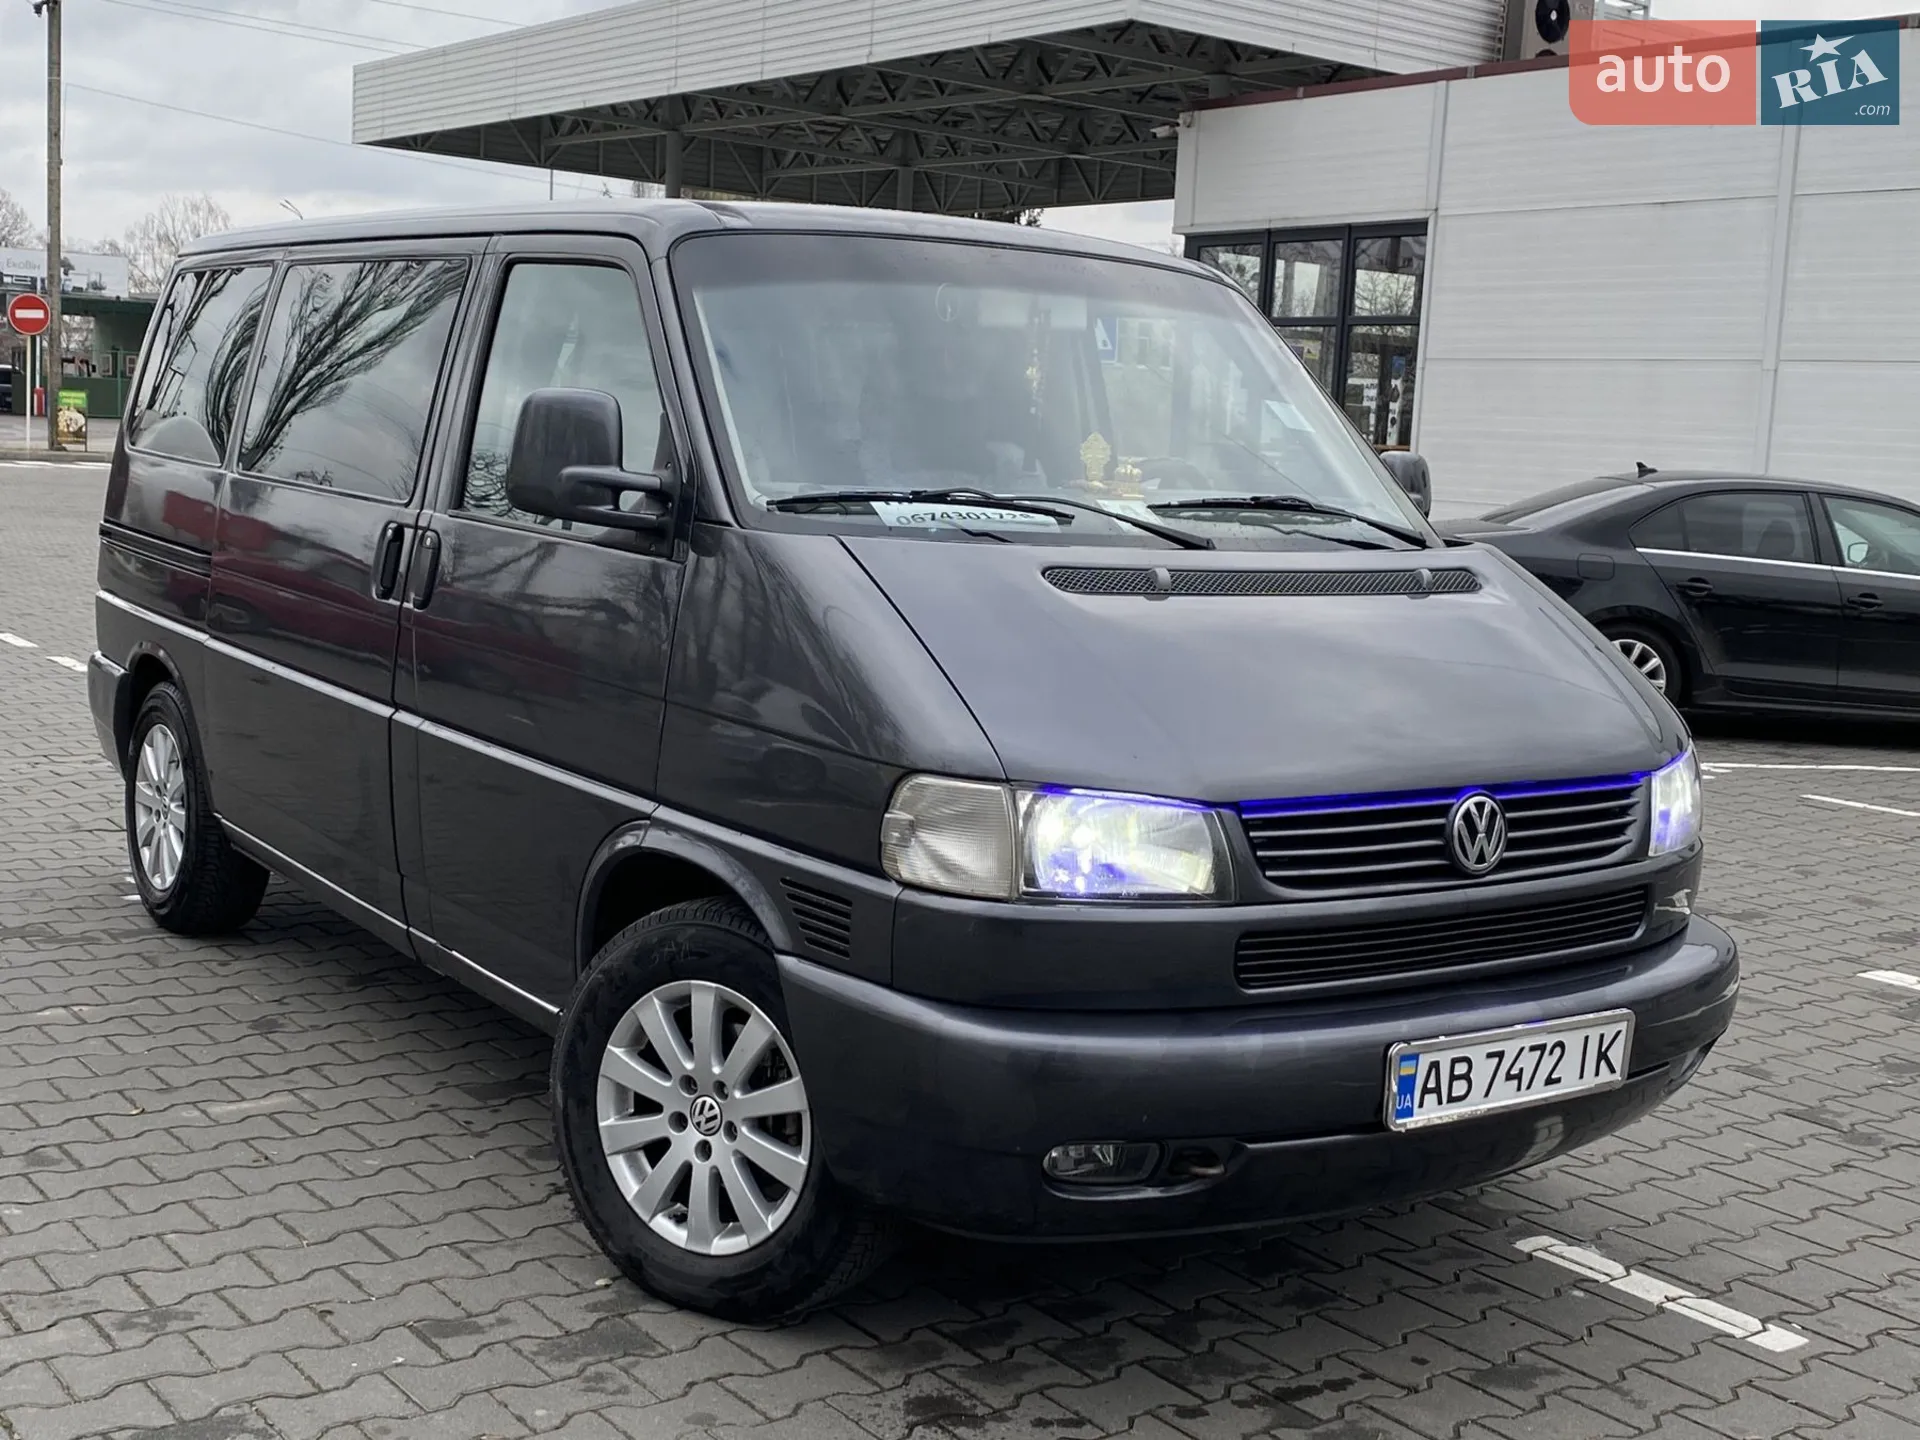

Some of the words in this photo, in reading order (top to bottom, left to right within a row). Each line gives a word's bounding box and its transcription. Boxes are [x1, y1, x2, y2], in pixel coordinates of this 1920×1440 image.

[1418, 1055, 1474, 1109] AB
[1484, 1040, 1566, 1098] 7472
[1579, 1029, 1623, 1080] IK
[1396, 1095, 1412, 1110] UA
